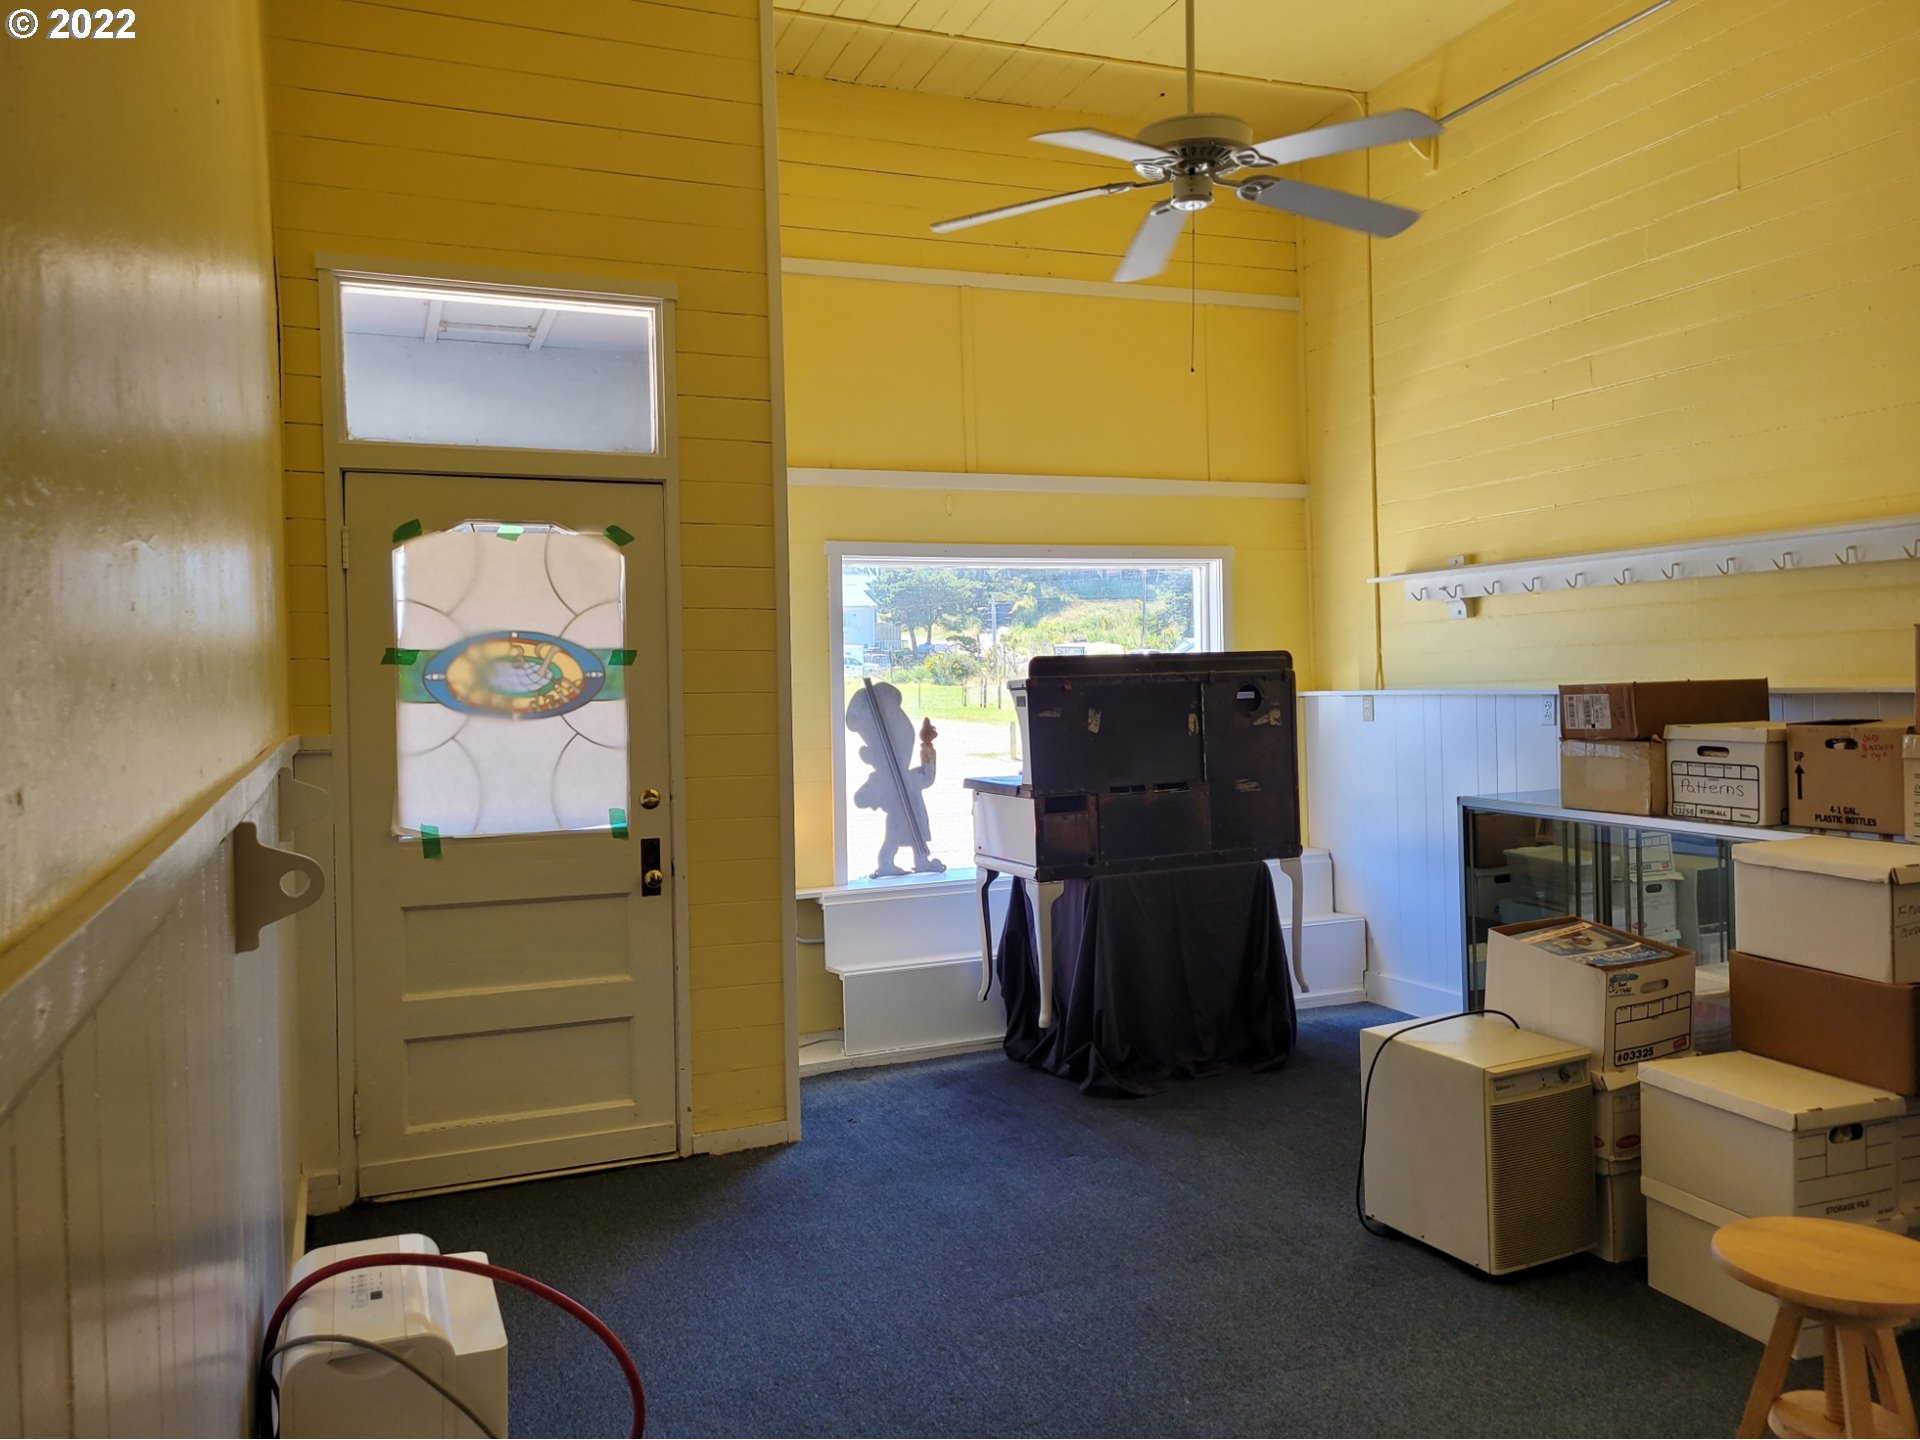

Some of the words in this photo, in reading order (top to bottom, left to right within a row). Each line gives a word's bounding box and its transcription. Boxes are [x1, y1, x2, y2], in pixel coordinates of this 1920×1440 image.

[1793, 751, 1804, 762] UP
[1680, 777, 1745, 798] Patterns
[1814, 813, 1843, 824] PLASTIC
[1845, 815, 1877, 827] BOTTLES
[1616, 1047, 1654, 1062] #03325
[1825, 1203, 1856, 1215] STORAGE
[1856, 1200, 1870, 1209] FILE
